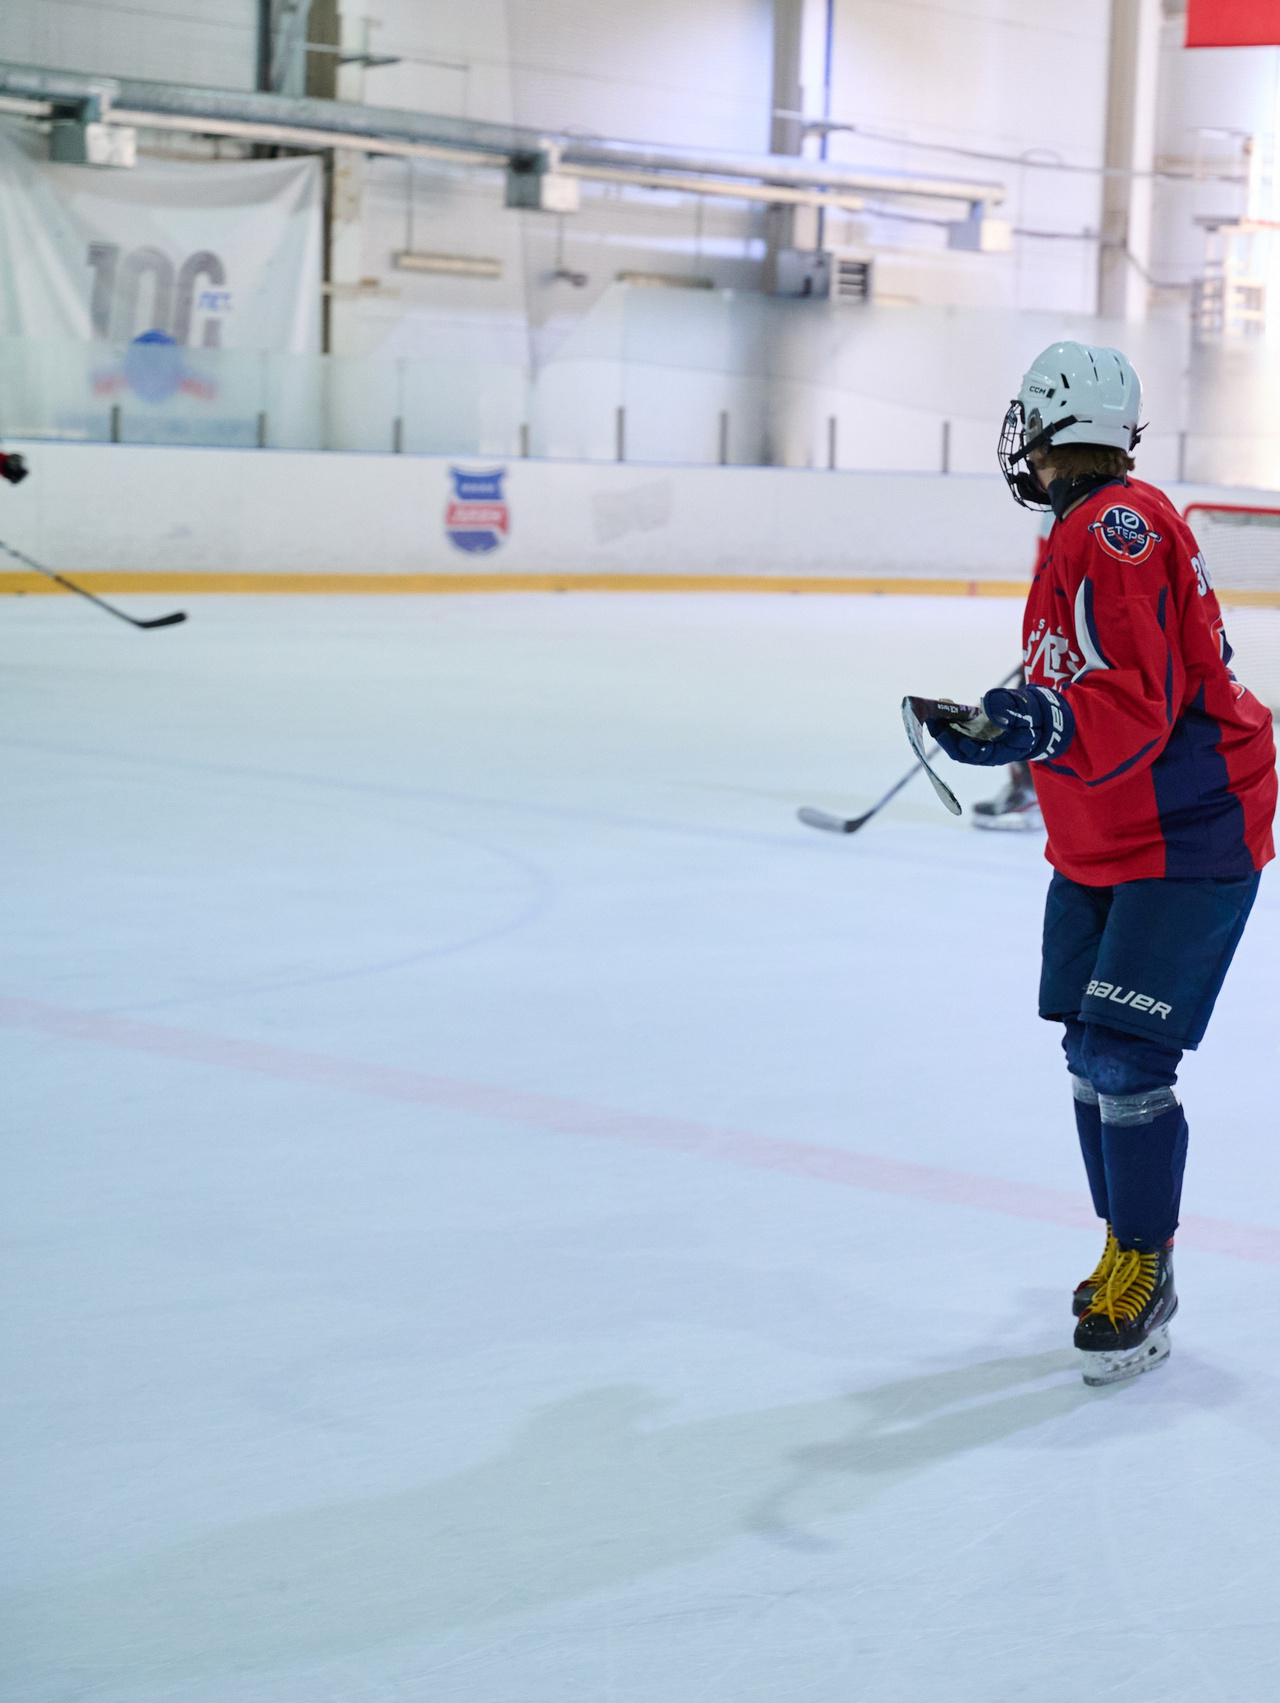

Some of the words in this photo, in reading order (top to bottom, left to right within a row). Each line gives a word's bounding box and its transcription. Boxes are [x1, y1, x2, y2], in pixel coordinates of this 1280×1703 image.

[1029, 385, 1046, 395] CCM
[1112, 509, 1140, 530] 10
[1106, 525, 1146, 544] STEPS
[1085, 979, 1173, 1020] BAUER
